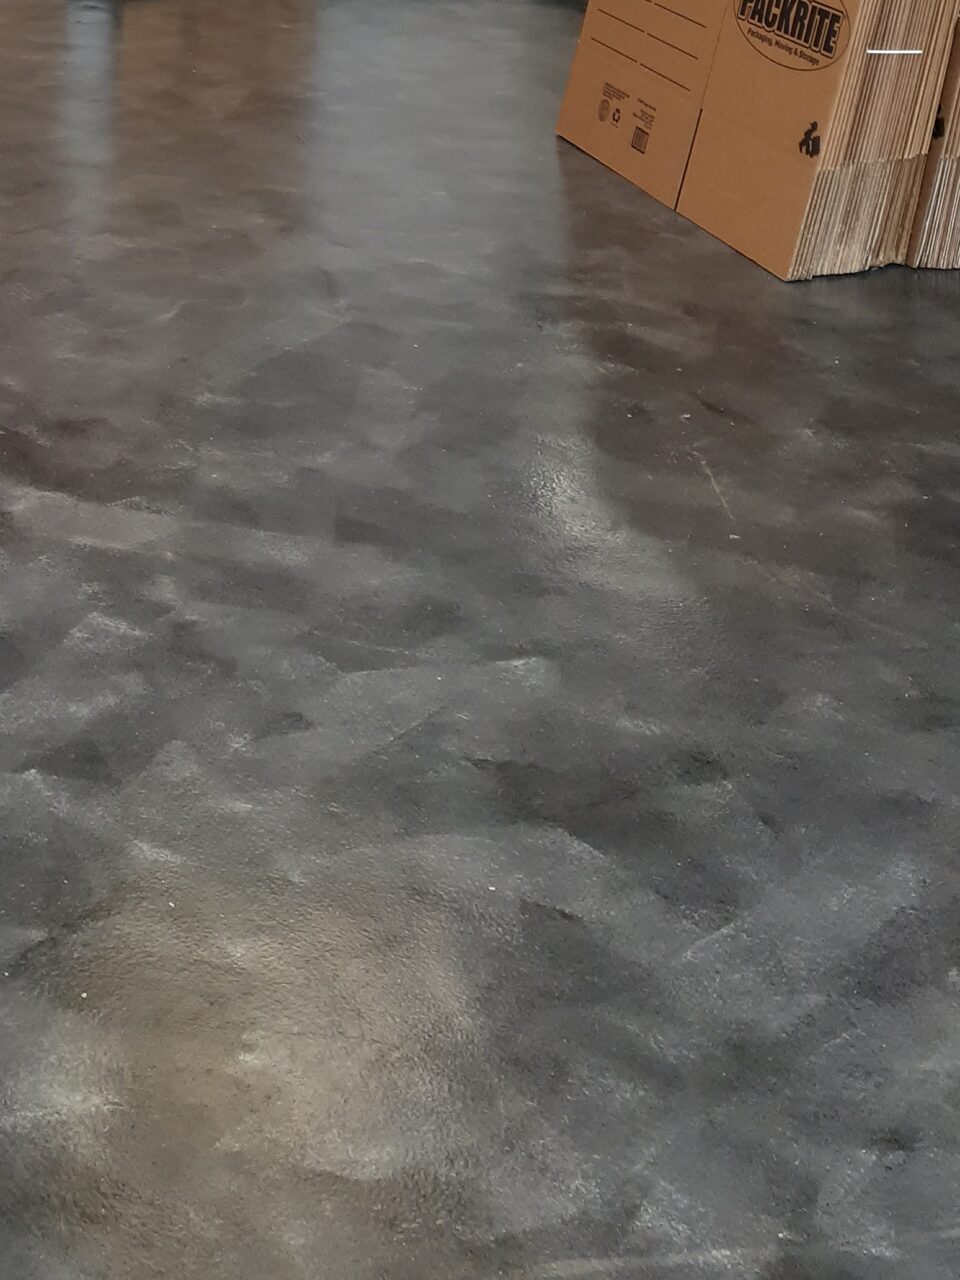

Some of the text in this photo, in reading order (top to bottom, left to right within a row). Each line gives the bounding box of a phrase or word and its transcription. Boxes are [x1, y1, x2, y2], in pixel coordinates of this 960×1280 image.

[747, 26, 820, 66] Packaging, Moving & Storage
